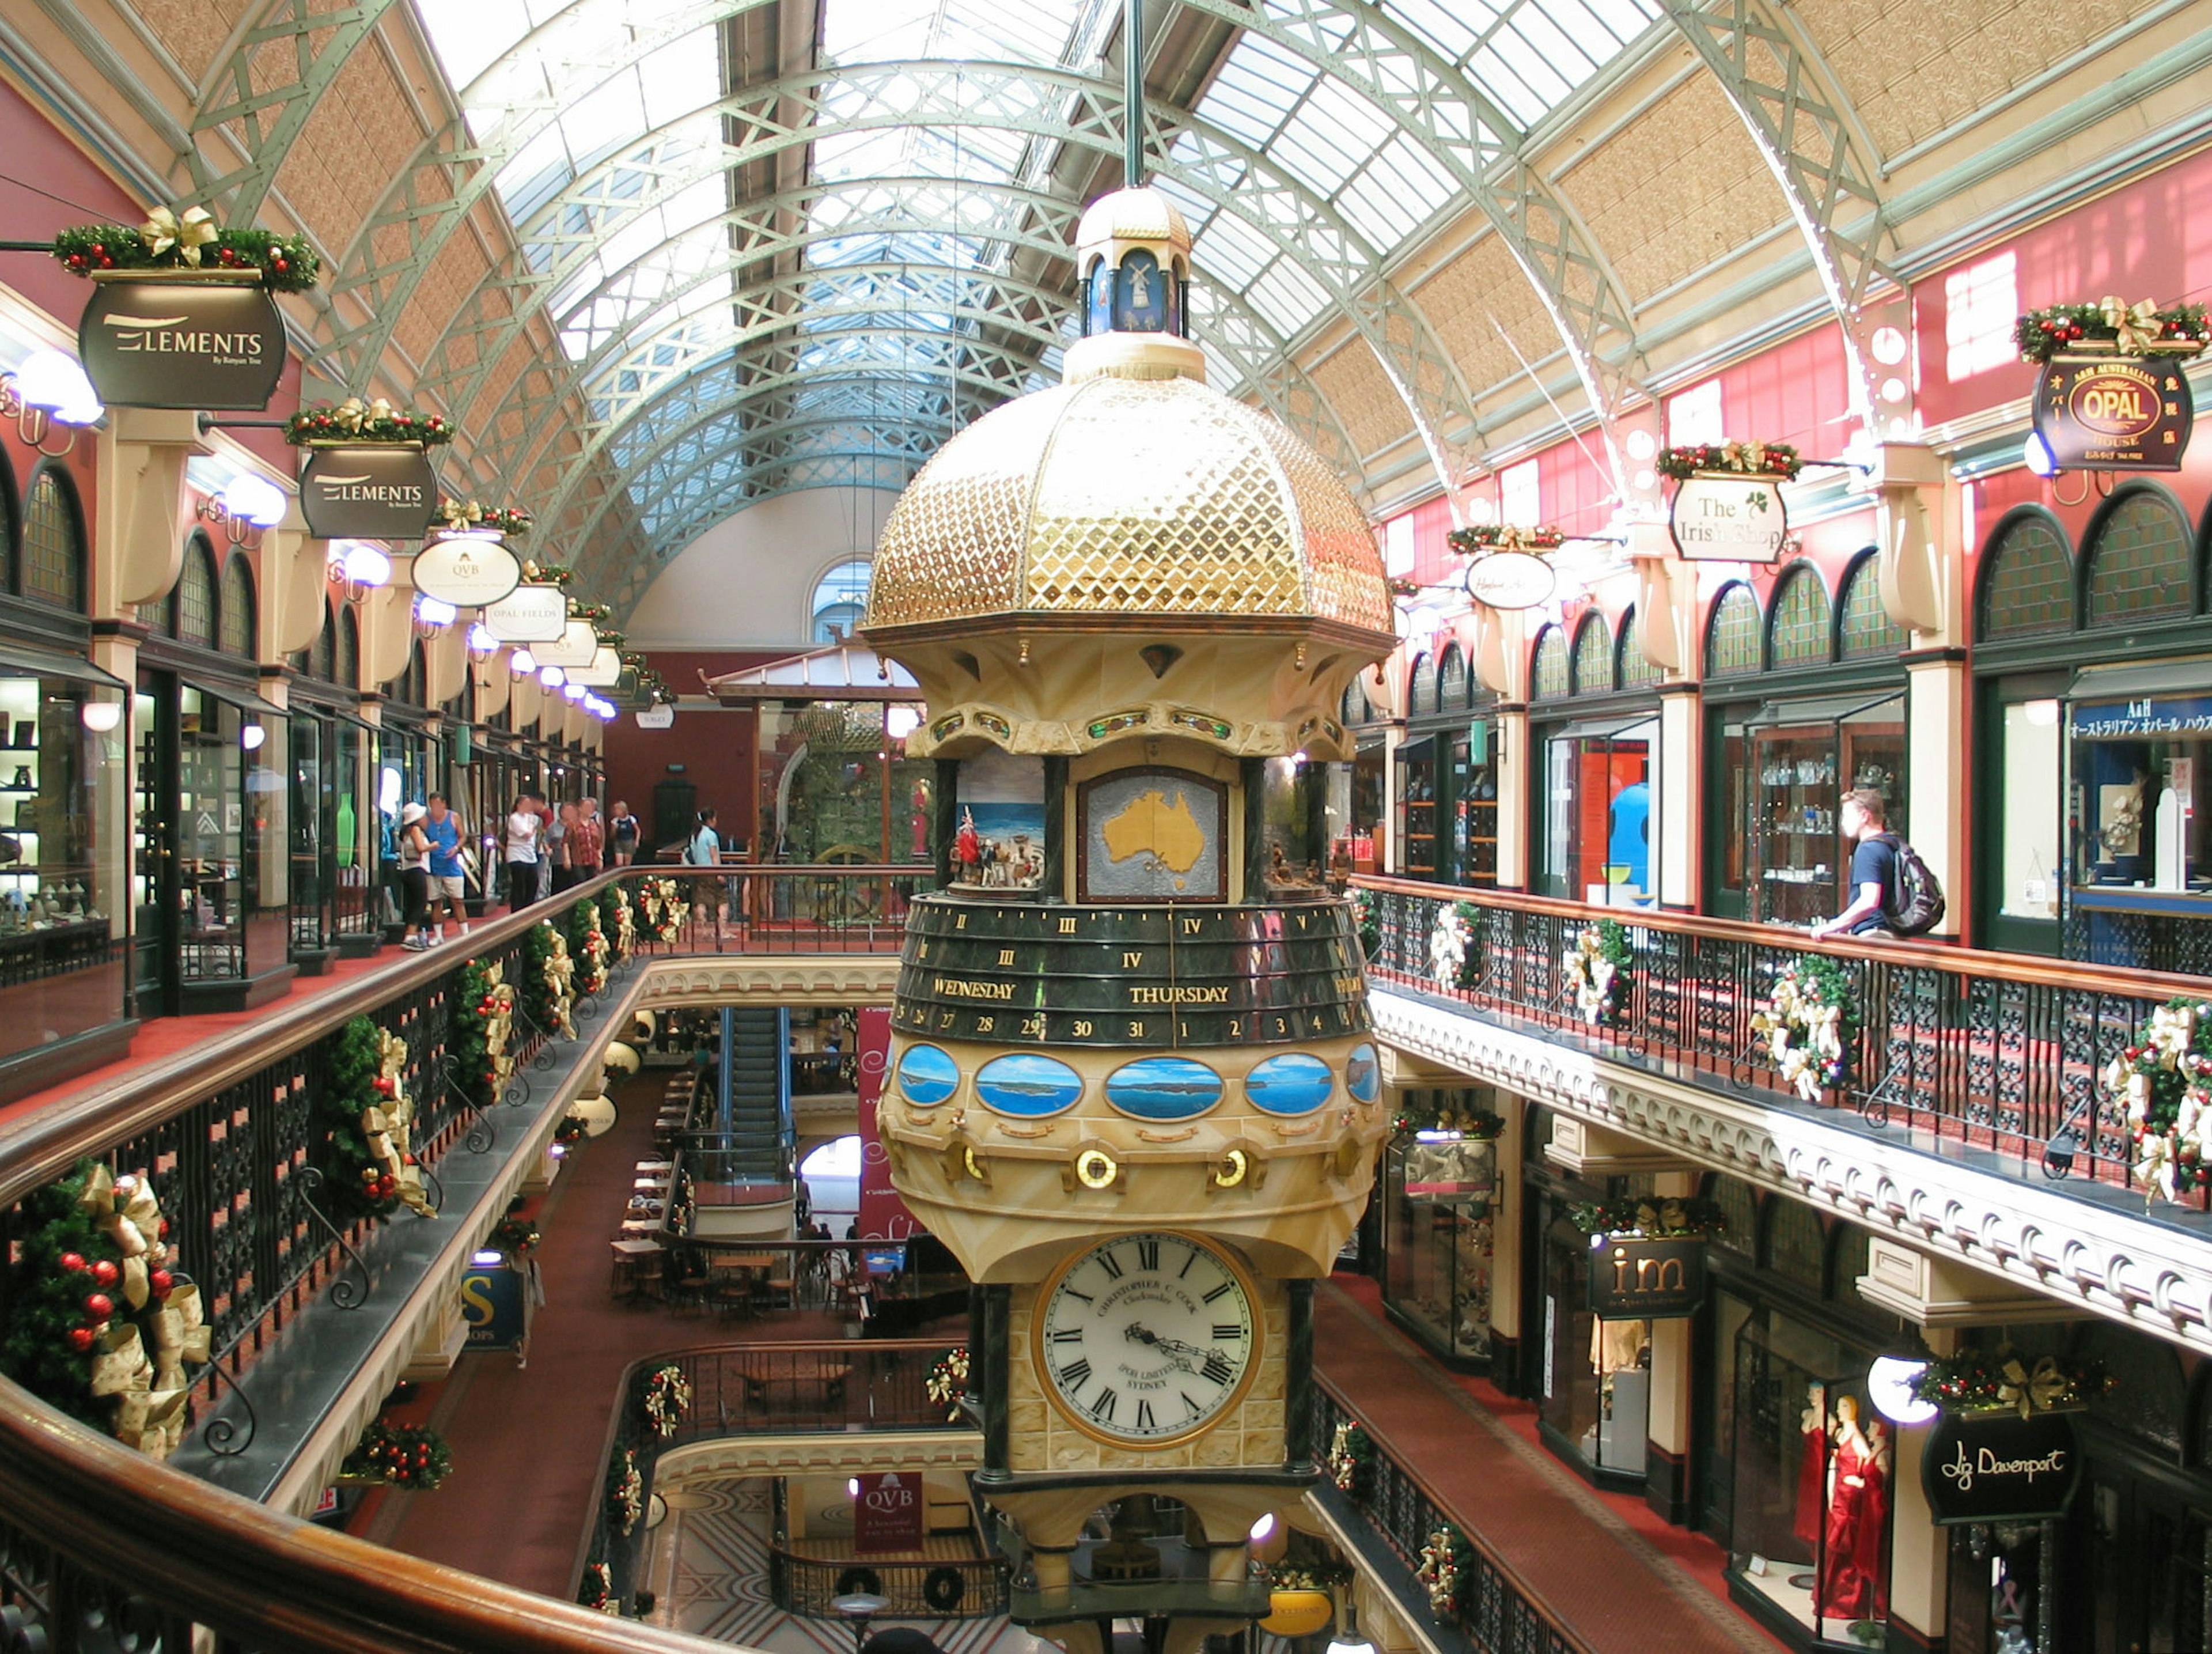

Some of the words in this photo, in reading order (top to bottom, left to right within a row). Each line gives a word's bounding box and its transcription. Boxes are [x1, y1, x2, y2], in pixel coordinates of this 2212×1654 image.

[104, 313, 262, 355] ELEMENTS
[213, 356, 221, 365] By
[223, 356, 247, 366] Banyan
[2074, 366, 2095, 383] A&H
[2097, 364, 2157, 385] AUSTRALIAN
[2083, 390, 2149, 420] OPAL
[2093, 435, 2141, 448] HOUSE
[314, 474, 422, 501] ELEMENTS
[1699, 498, 1736, 517] The
[1680, 521, 1727, 543] Irish
[1734, 524, 1780, 549] Shop
[452, 564, 479, 578] QVB
[494, 610, 518, 618] OPAL
[522, 610, 557, 618] FIELDS
[2127, 698, 2152, 718] A&H
[2141, 718, 2181, 735] オパール
[1058, 918, 1077, 933] III
[1183, 918, 1202, 934] IV
[998, 949, 1015, 966] III
[1122, 952, 1143, 968] IV
[934, 978, 1016, 1000] WEDNESDAY
[1130, 986, 1229, 1004] THURSDAY
[940, 1013, 955, 1029] 27
[977, 1016, 994, 1032] 28
[1021, 1019, 1040, 1035] 29
[1072, 1020, 1092, 1037] 30
[1128, 1021, 1144, 1038] 31
[1181, 1022, 1188, 1037] 1
[1229, 1020, 1241, 1036] 2
[1276, 1017, 1286, 1034] 3
[1313, 1015, 1322, 1030] 4
[1096, 1251, 1124, 1283] XI
[1138, 1242, 1159, 1271] XII
[1612, 1247, 1686, 1293] im
[1097, 1280, 1160, 1318] CHRISTOPHER
[1165, 1284, 1173, 1293] C
[1176, 1290, 1198, 1315] COOK
[1201, 1281, 1232, 1305] II
[1054, 1326, 1083, 1343] IX
[1212, 1323, 1241, 1341] III
[1060, 1354, 1092, 1395] VIII
[1141, 1362, 1177, 1379] LIMITED
[1127, 1380, 1168, 1390] SYDNEY
[1091, 1386, 1118, 1422] VII
[1941, 1440, 1974, 1490] Liz
[1978, 1447, 2066, 1483] Davenport
[866, 1490, 912, 1513] QVB
